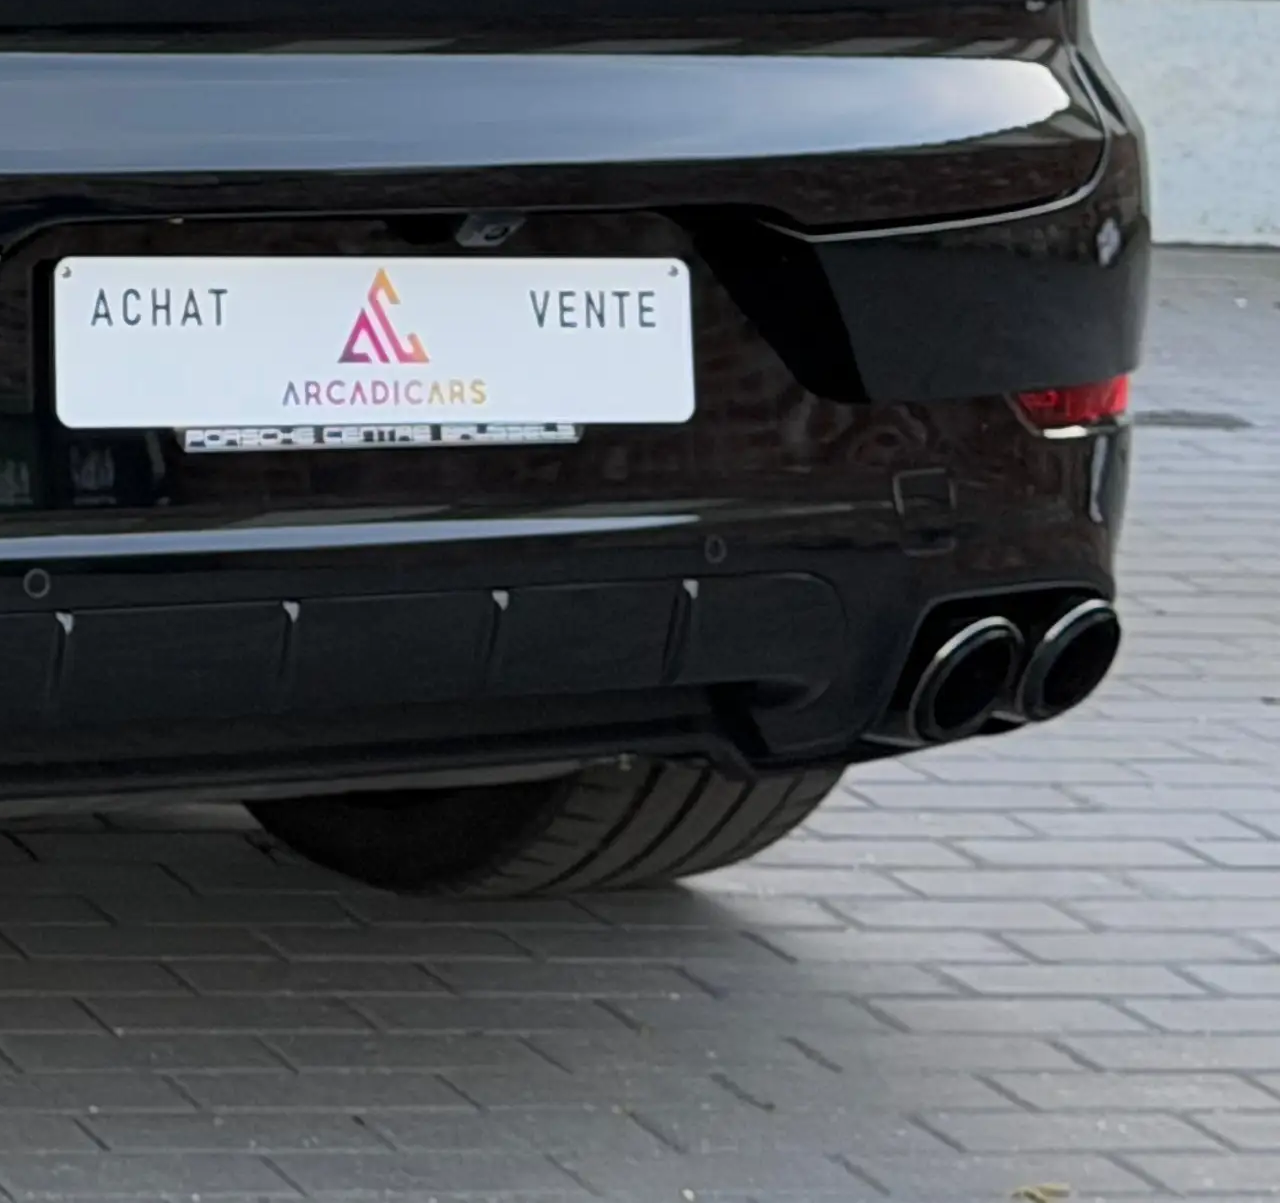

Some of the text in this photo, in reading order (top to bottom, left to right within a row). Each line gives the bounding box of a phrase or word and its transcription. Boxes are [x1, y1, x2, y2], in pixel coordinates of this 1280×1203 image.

[90, 288, 657, 329] ACHAT VENTE
[281, 379, 487, 406] ARCADICARS
[185, 428, 315, 448] PORSCHE
[323, 426, 431, 446] CENTRE
